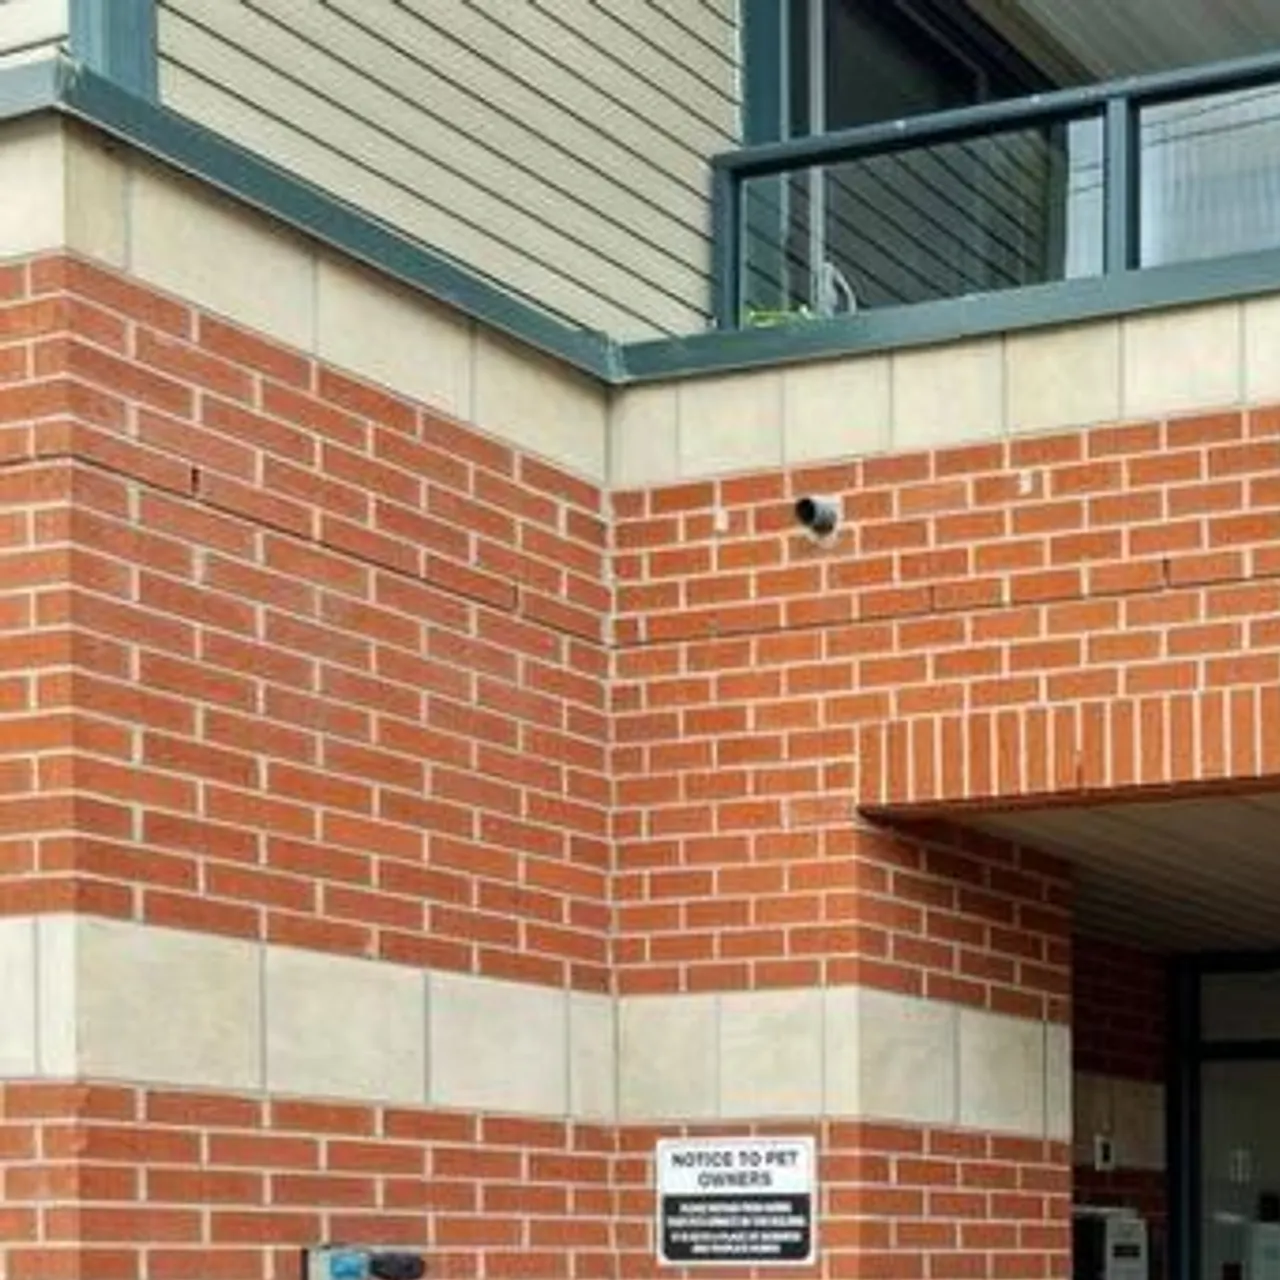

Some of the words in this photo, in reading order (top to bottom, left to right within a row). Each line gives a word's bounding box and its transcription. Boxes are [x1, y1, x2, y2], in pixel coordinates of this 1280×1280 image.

[672, 1151, 733, 1167] NOTICE
[739, 1151, 762, 1166] TO
[766, 1150, 798, 1165] PET
[698, 1171, 772, 1187] OWNERS
